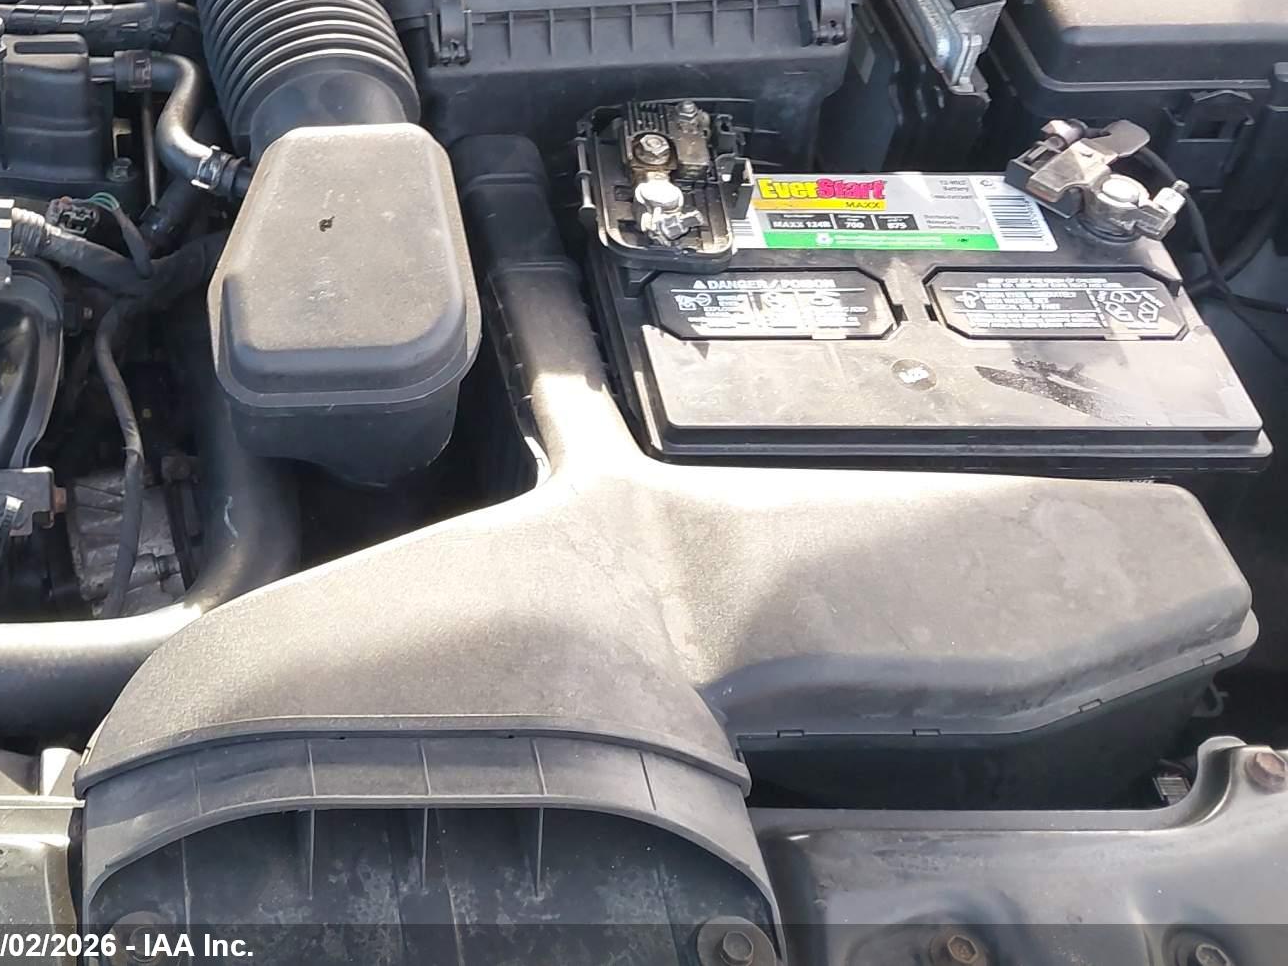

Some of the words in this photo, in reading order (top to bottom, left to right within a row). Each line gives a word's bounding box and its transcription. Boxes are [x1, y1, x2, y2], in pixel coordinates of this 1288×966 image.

[757, 178, 887, 199] EverStart
[845, 201, 881, 209] MAXX
[707, 280, 768, 289] DANGER
